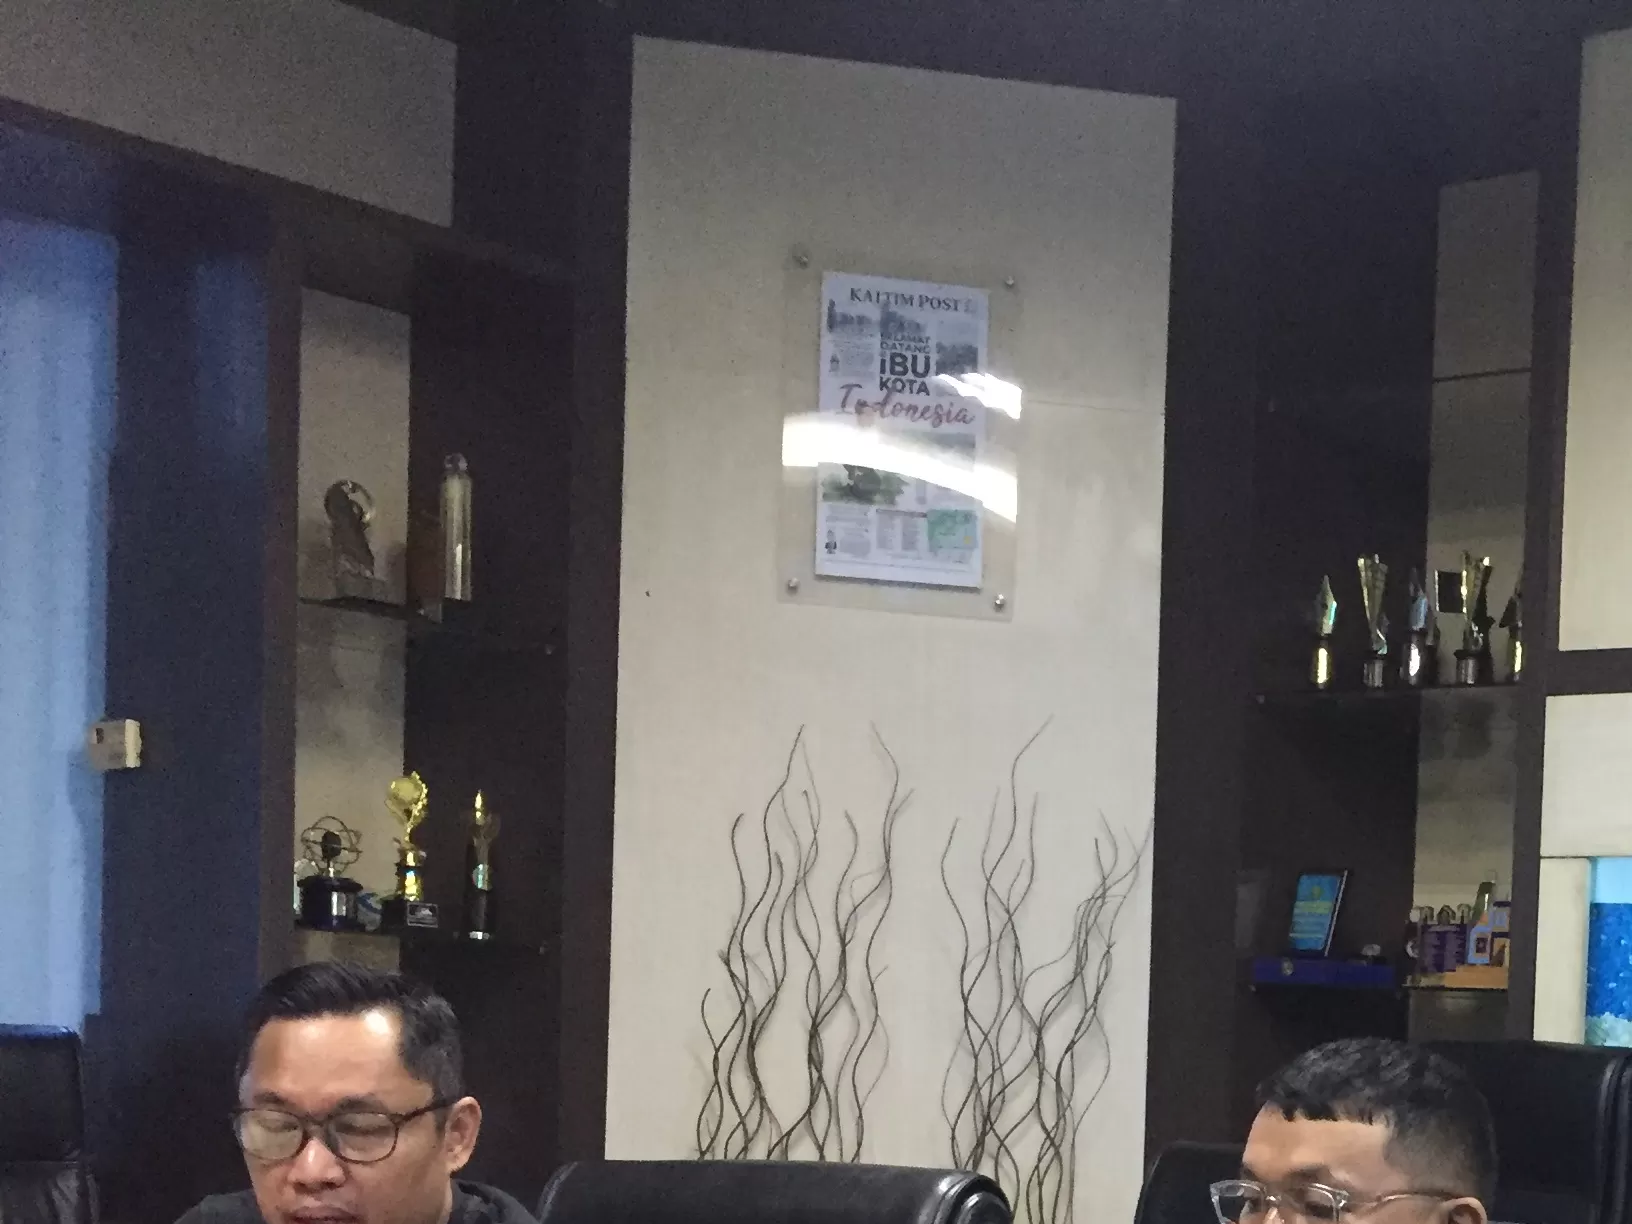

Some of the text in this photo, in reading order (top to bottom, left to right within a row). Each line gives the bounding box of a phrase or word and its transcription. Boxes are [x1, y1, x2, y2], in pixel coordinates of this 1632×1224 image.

[850, 287, 914, 308] KALTIM
[917, 294, 961, 313] POST
[879, 376, 930, 396] KOTA
[836, 383, 976, 428] Indonesia
